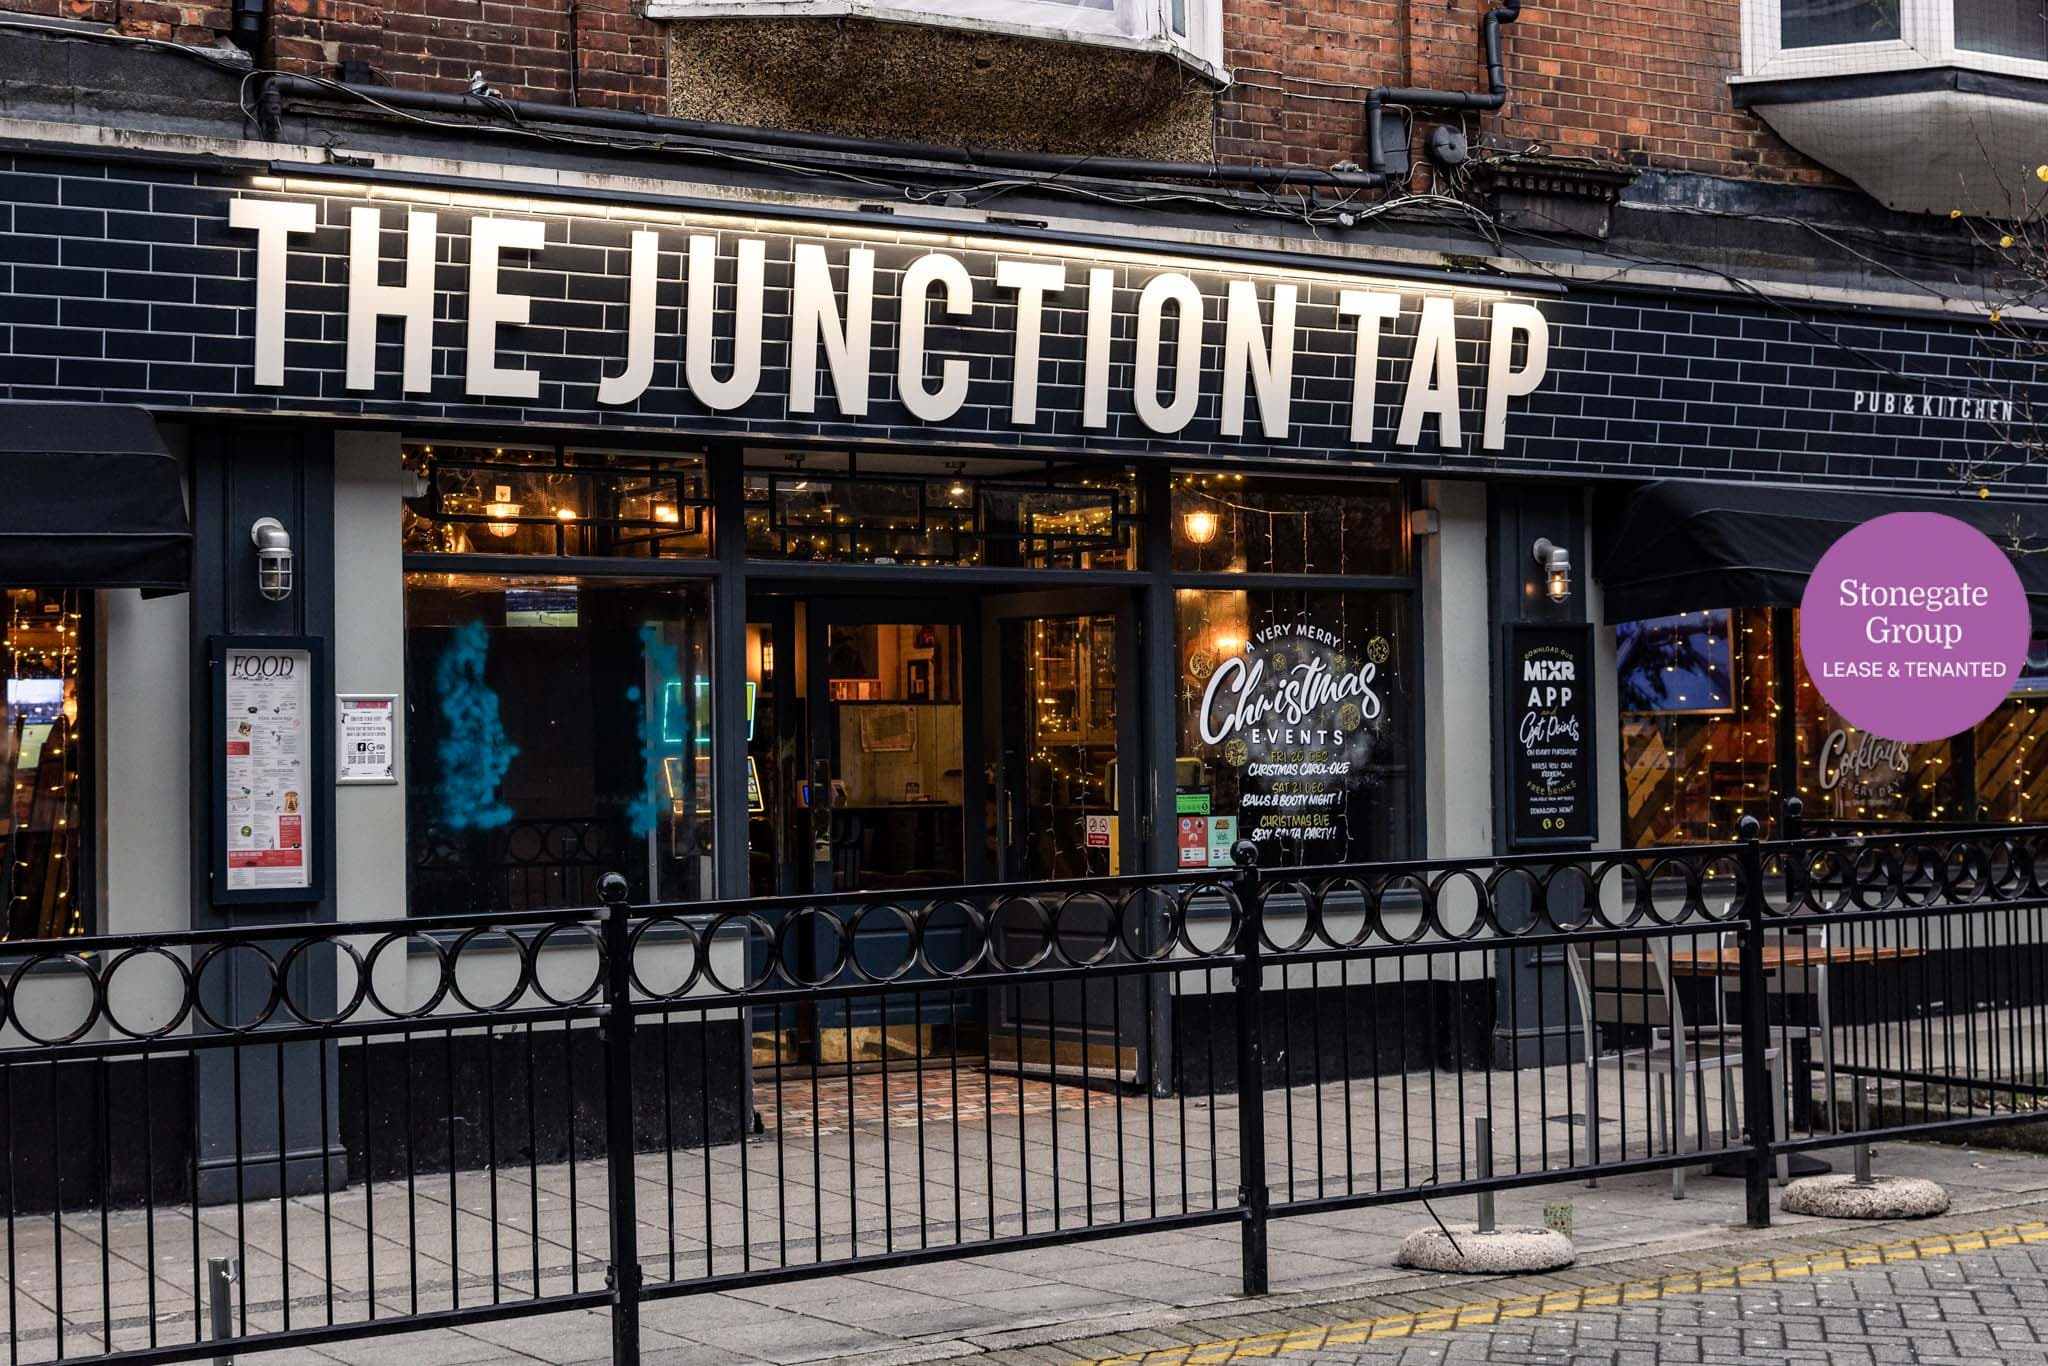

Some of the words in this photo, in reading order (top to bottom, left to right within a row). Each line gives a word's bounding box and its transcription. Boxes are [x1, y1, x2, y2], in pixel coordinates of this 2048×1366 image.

[229, 198, 546, 399] THE
[597, 230, 1298, 438] JUNCTION
[1340, 290, 1550, 450] TAP
[1853, 391, 1895, 414] PUB
[1903, 394, 1915, 415] &
[1923, 395, 2013, 421] KITCHEN
[1245, 640, 1255, 654] A
[1256, 623, 1292, 644] VERY
[1296, 623, 1342, 648] MERRY
[231, 655, 294, 677] FOOD
[1200, 656, 1381, 745] Christmas
[1527, 686, 1573, 707] APP
[1252, 728, 1344, 745] EVENTS
[1520, 711, 1546, 749] Get
[1271, 751, 1287, 762] FRI
[1308, 751, 1329, 762] DEC
[1248, 762, 1298, 777] CHRISTMAS
[1300, 761, 1351, 776] CAROL-OKE
[1271, 782, 1290, 794] SAT
[1305, 782, 1325, 794] DEC
[1242, 793, 1271, 807] BALLS
[1271, 794, 1279, 806] &
[1279, 794, 1309, 807] BOOTY
[1260, 814, 1312, 828] CHRISTMAS
[1313, 813, 1330, 826] EVE
[1251, 827, 1273, 841] SEXY
